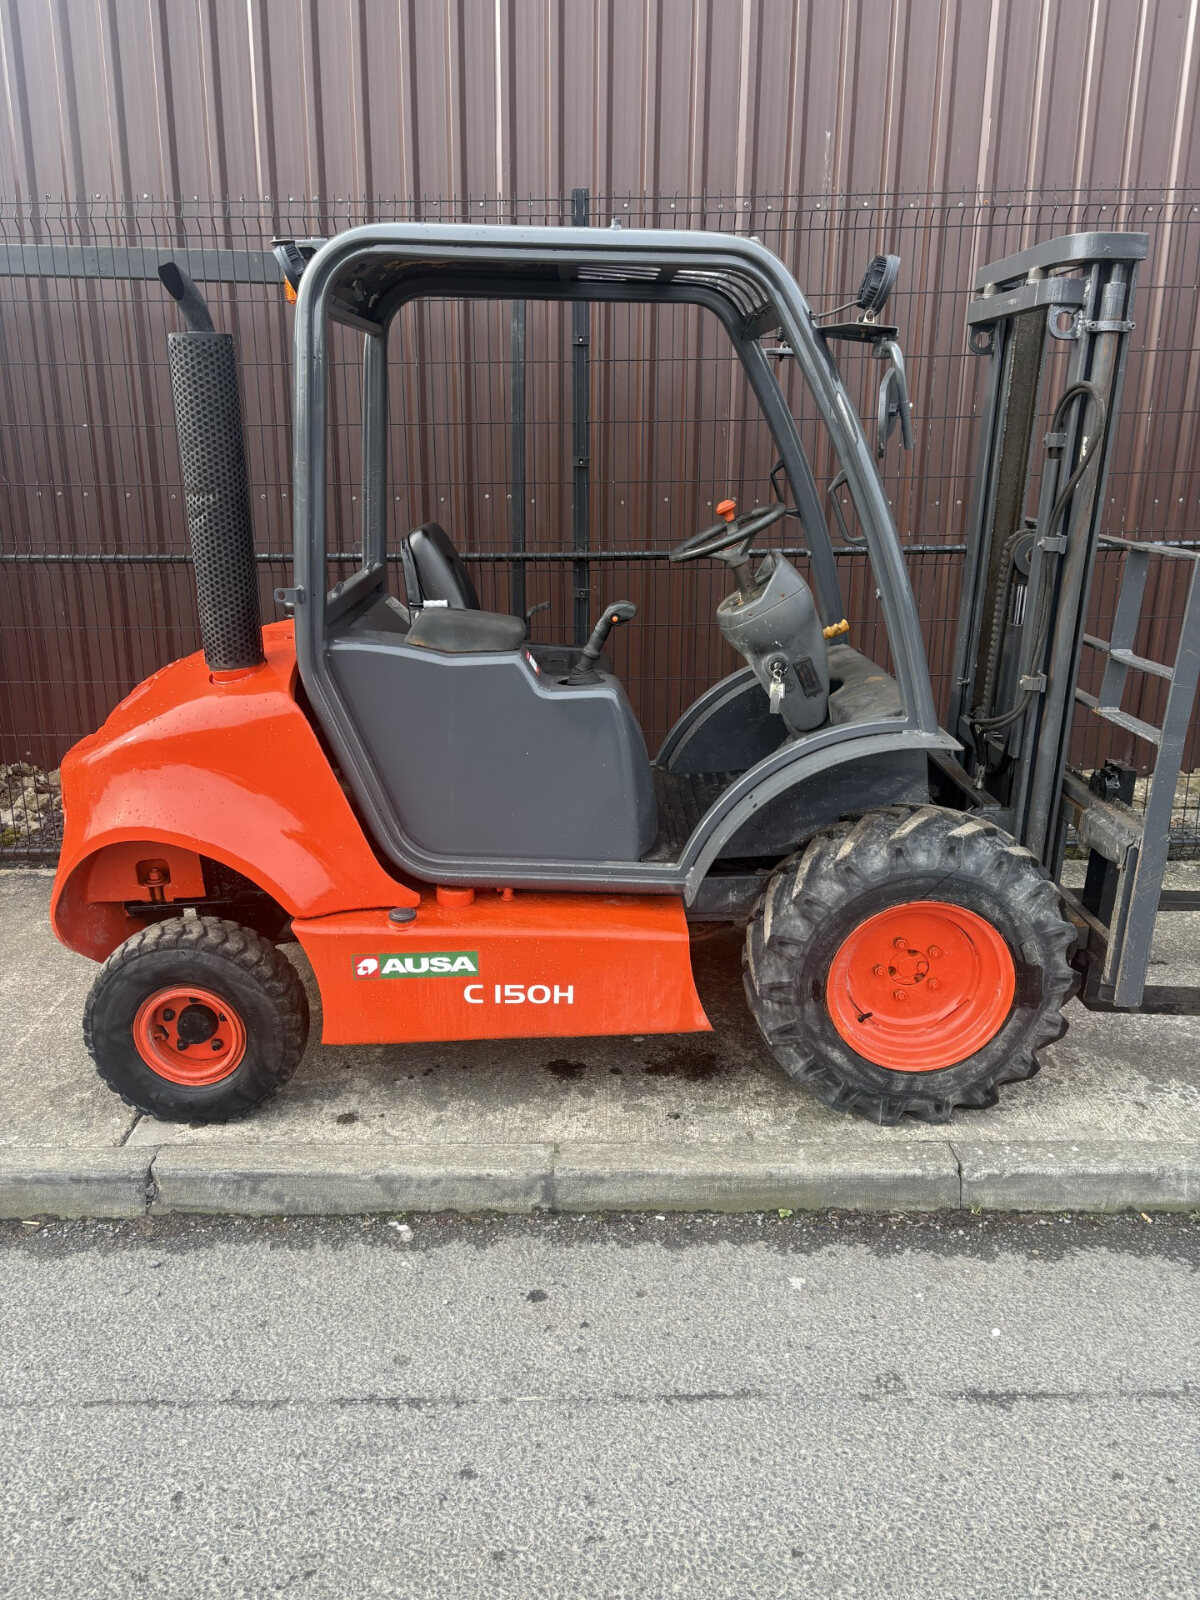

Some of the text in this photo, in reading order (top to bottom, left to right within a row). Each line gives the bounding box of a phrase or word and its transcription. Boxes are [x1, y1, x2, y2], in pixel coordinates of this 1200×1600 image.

[380, 956, 477, 975] AUSA
[464, 984, 574, 1004] C 150H
